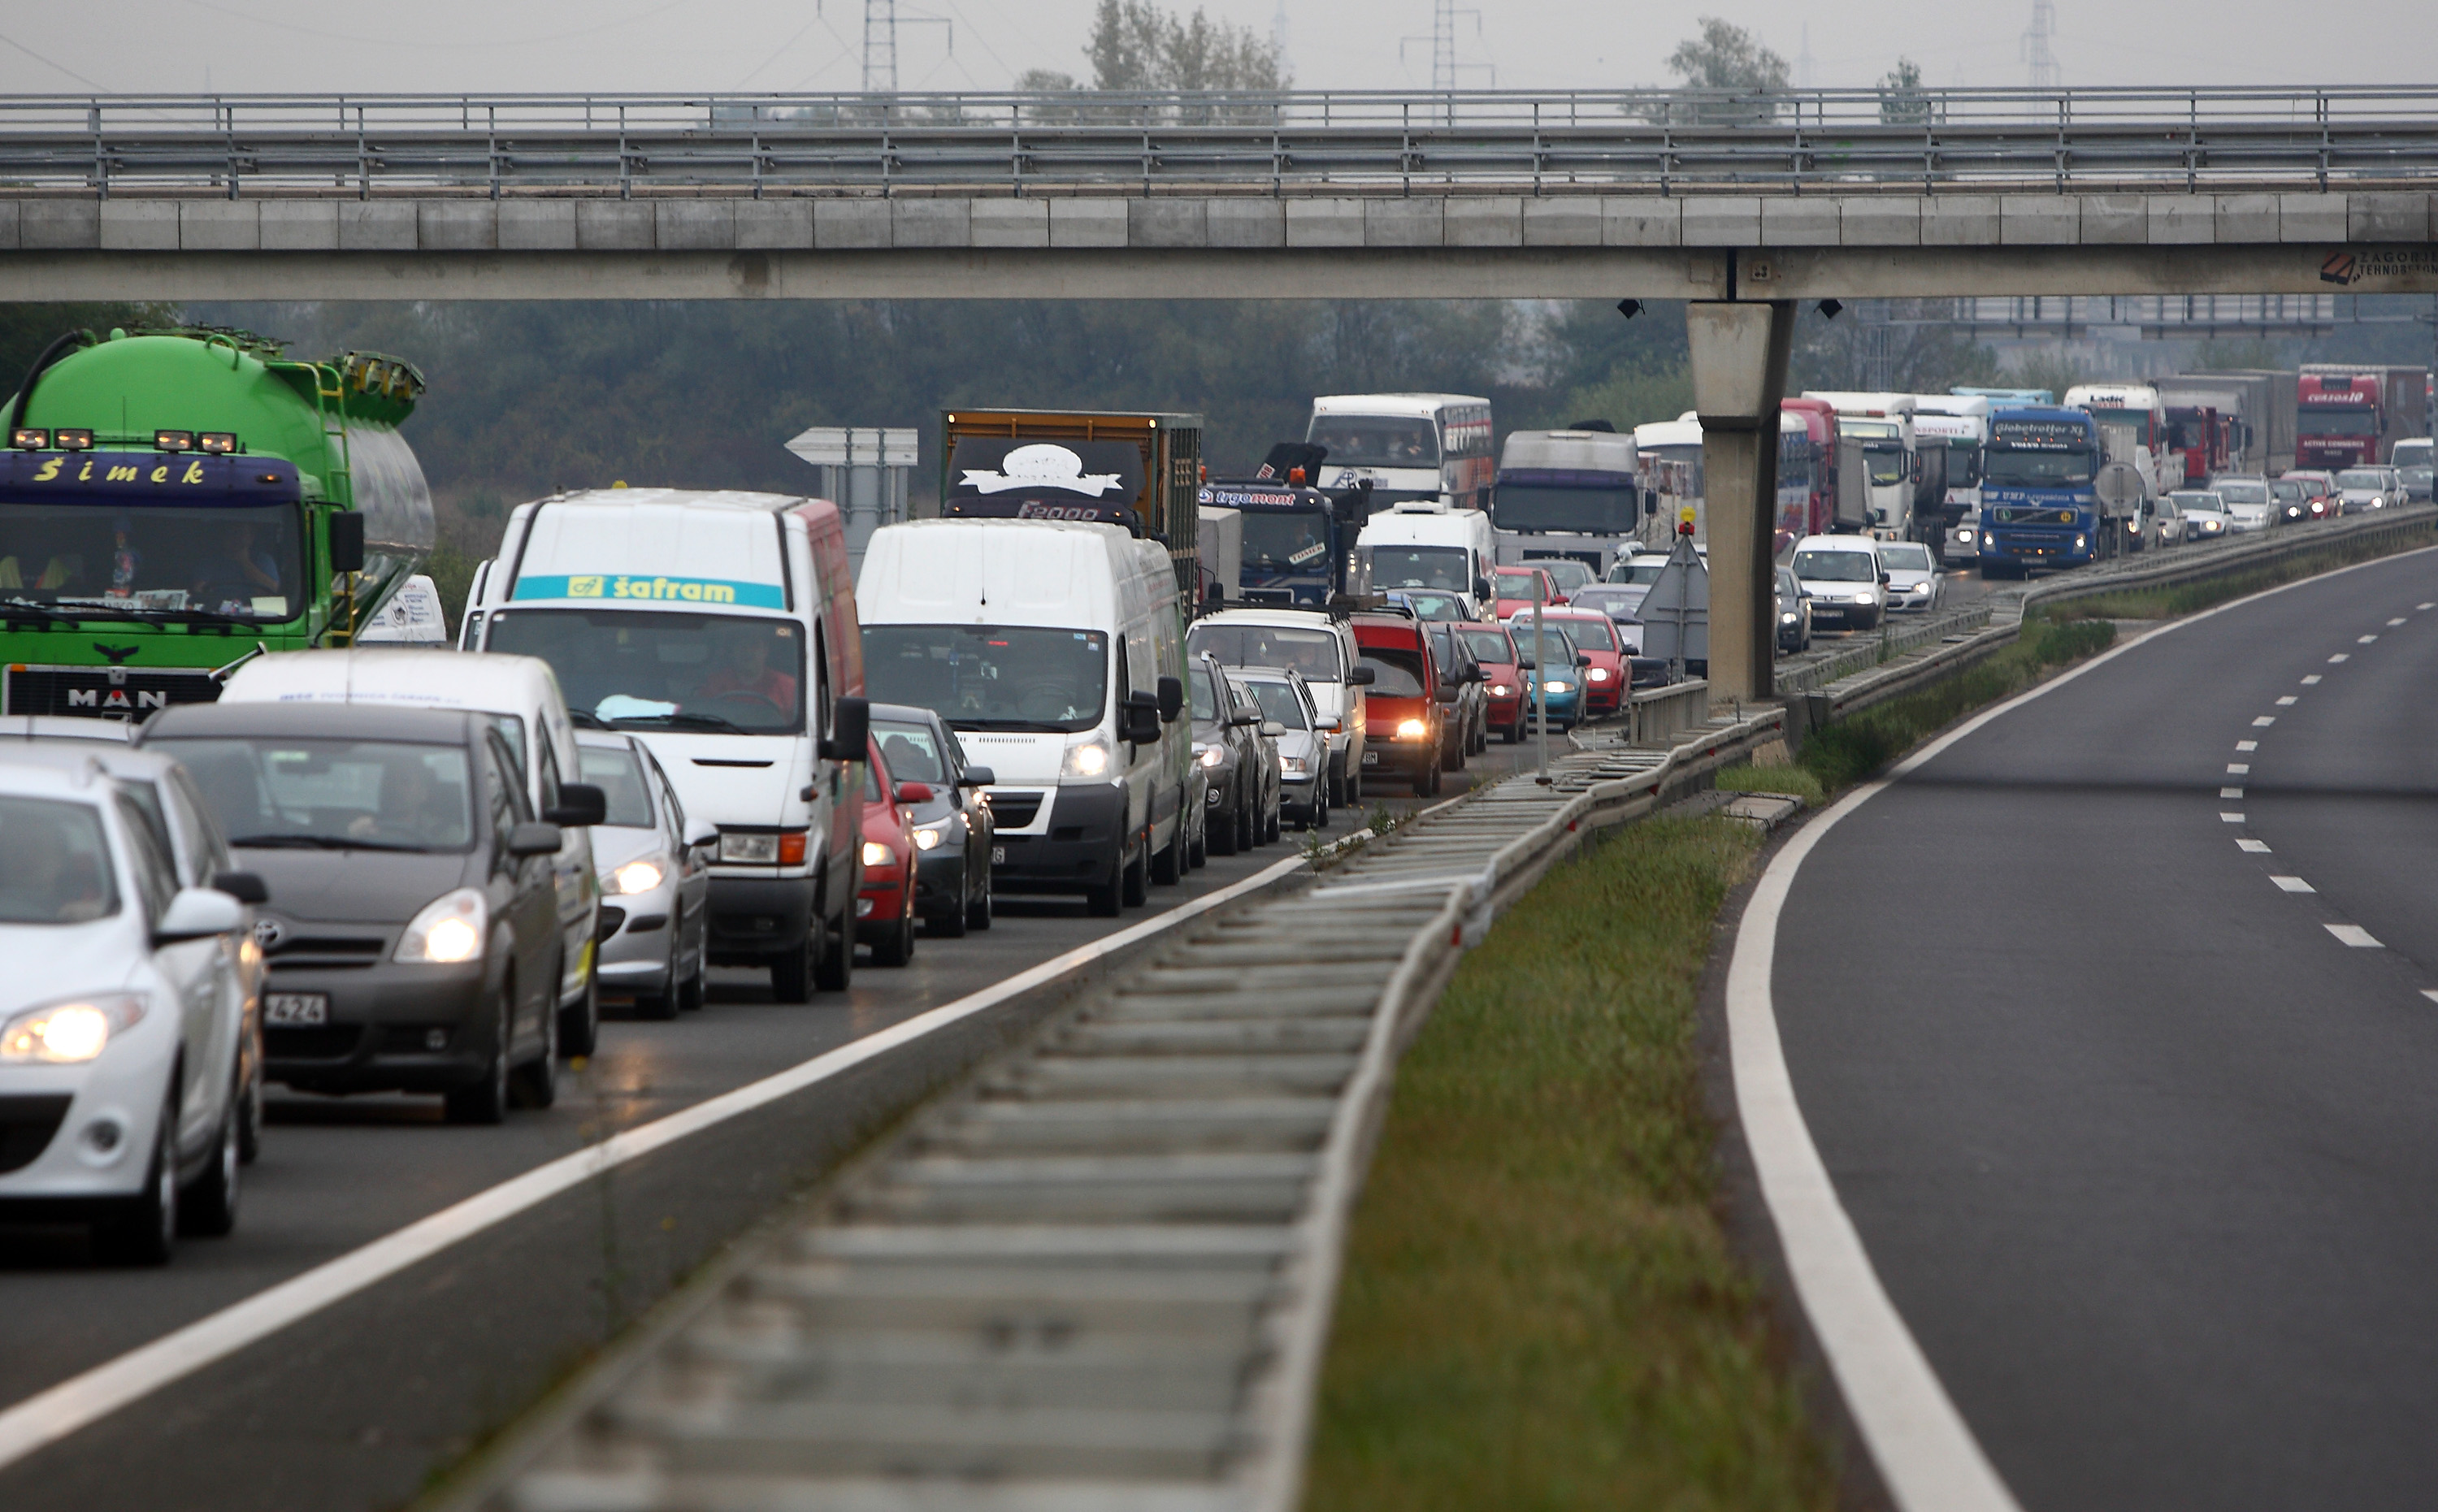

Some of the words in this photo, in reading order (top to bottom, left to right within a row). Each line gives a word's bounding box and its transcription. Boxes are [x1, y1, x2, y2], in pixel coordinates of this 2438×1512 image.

[33, 457, 203, 485] Šimek
[614, 576, 735, 604] šafram
[67, 688, 167, 708] MAN
